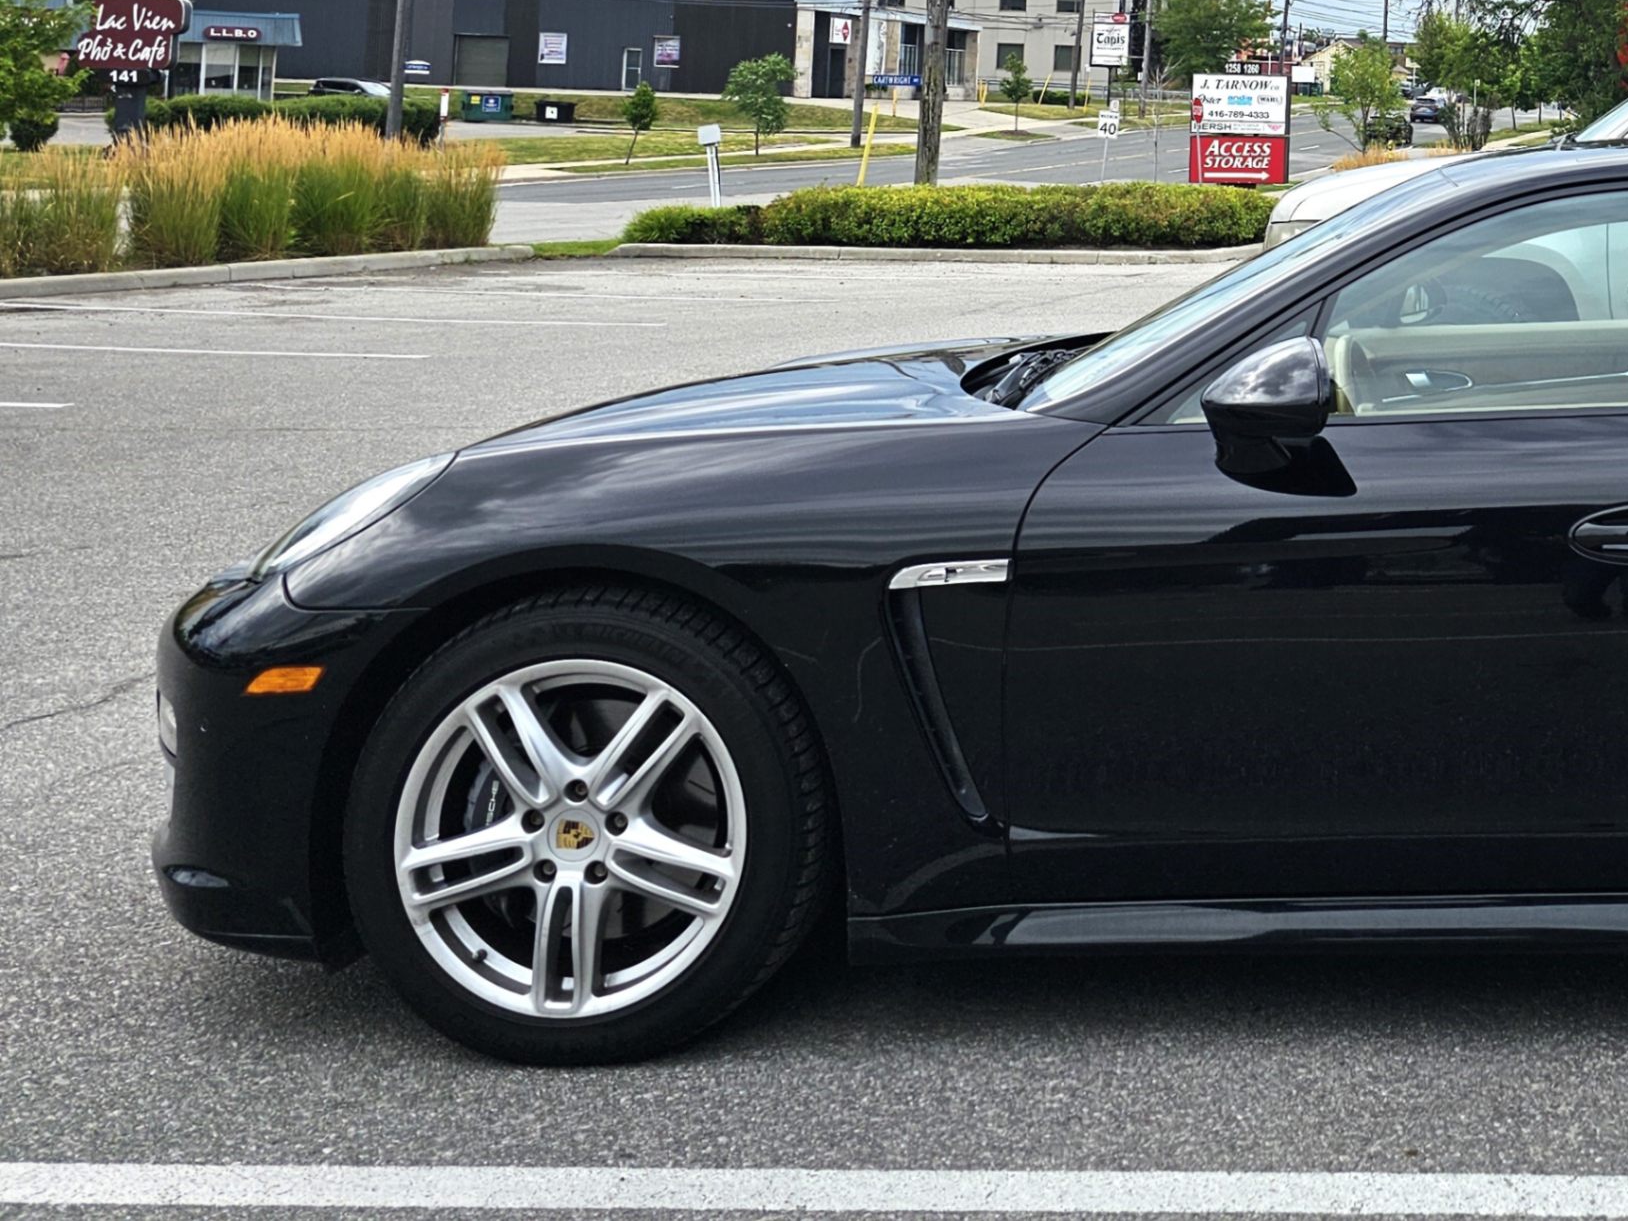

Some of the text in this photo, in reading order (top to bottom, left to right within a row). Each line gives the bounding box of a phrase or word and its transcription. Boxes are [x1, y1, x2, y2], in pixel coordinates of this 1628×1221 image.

[95, 3, 176, 31] Lac Vien
[1096, 33, 1126, 47] Tapis
[113, 42, 127, 59] &
[128, 38, 166, 68] Café
[1224, 63, 1241, 73] 1258
[109, 69, 138, 83] 141
[873, 75, 911, 85] CARTWRIGHT
[1200, 79, 1210, 90] J.
[1215, 79, 1272, 90] TARNOW
[1208, 110, 1270, 119] 416-789-4333
[1099, 122, 1117, 136] 40
[1205, 139, 1272, 156] ACCESS
[1203, 156, 1271, 169] STORAGE
